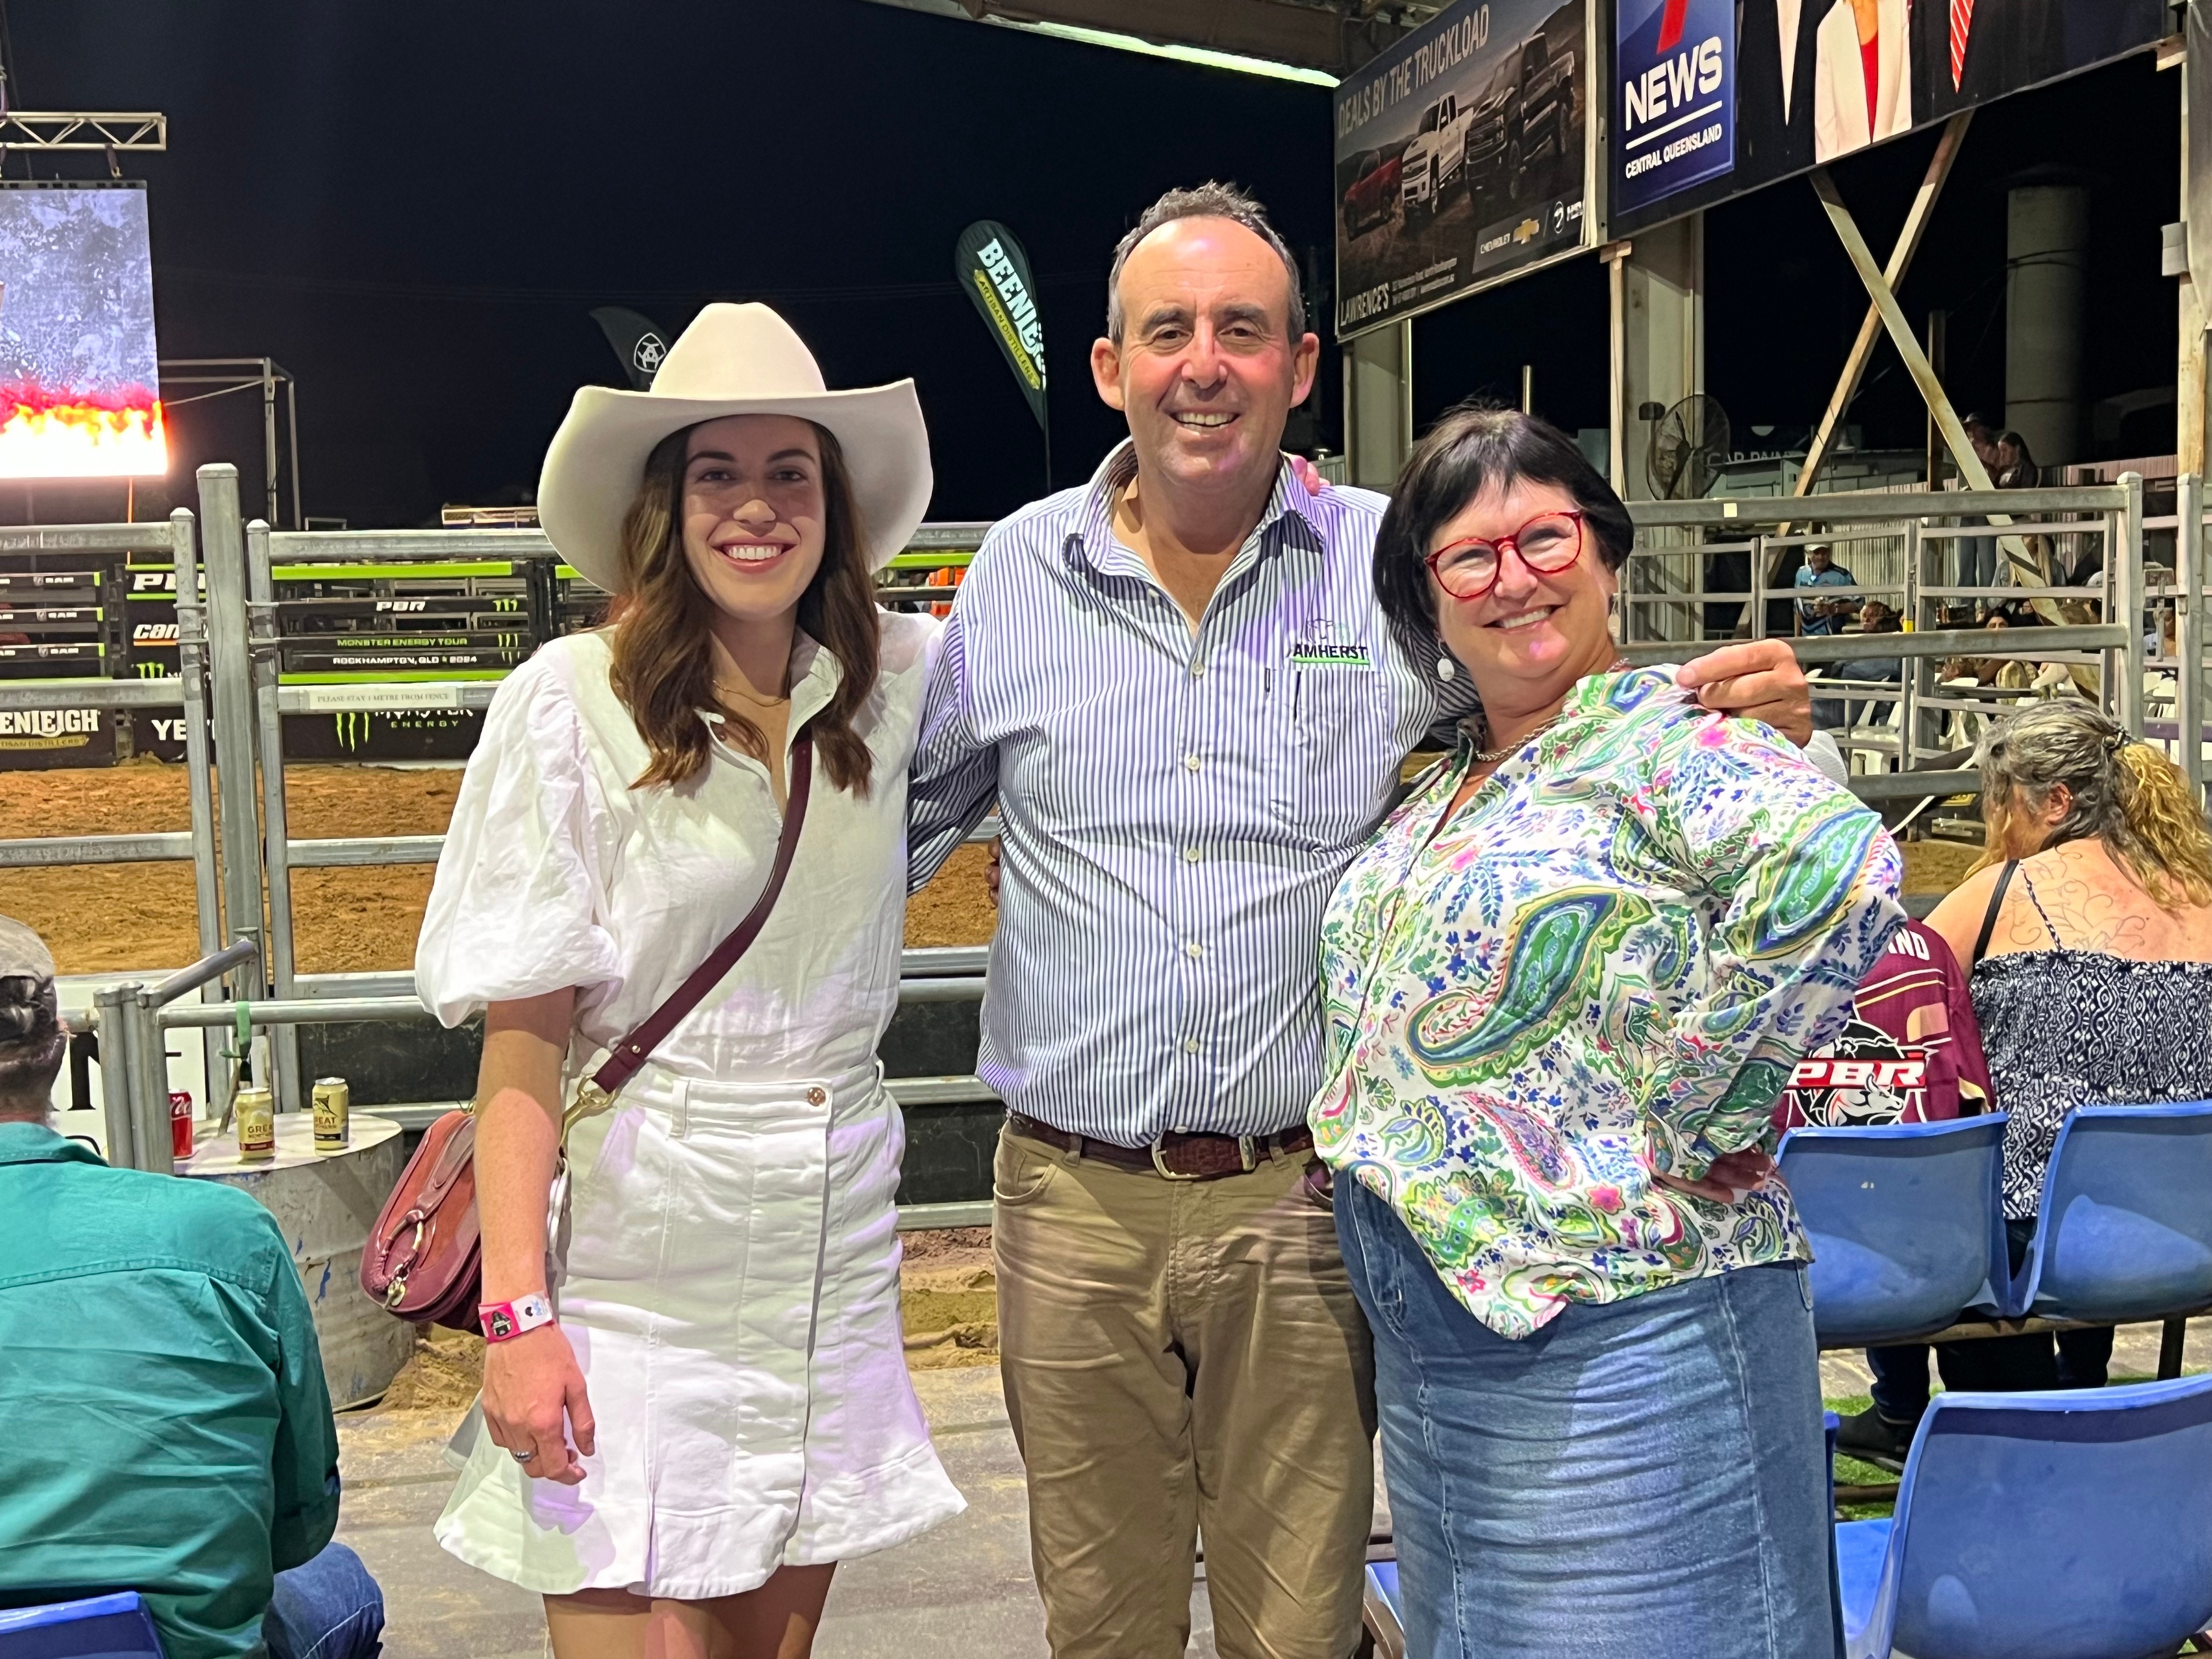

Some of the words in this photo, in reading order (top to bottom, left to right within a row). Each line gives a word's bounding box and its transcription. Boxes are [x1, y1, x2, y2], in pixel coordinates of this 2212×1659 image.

[1339, 86, 1369, 139] DEALS
[1373, 72, 1387, 117] BY
[1390, 56, 1412, 105] THE
[1415, 4, 1488, 89] TRUCKLOAD
[1626, 36, 1722, 131] NEWS
[1626, 150, 1662, 179] CENTRAL
[1663, 123, 1722, 162] QUEENSLAND
[337, 638, 391, 646] MONSTER
[392, 637, 436, 646] ENERGY
[438, 637, 467, 646] TOUR
[1293, 644, 1368, 659] AMHERST
[418, 656, 439, 664] QLD
[391, 720, 459, 729] ENERGY
[1787, 1061, 1925, 1086] PBR
